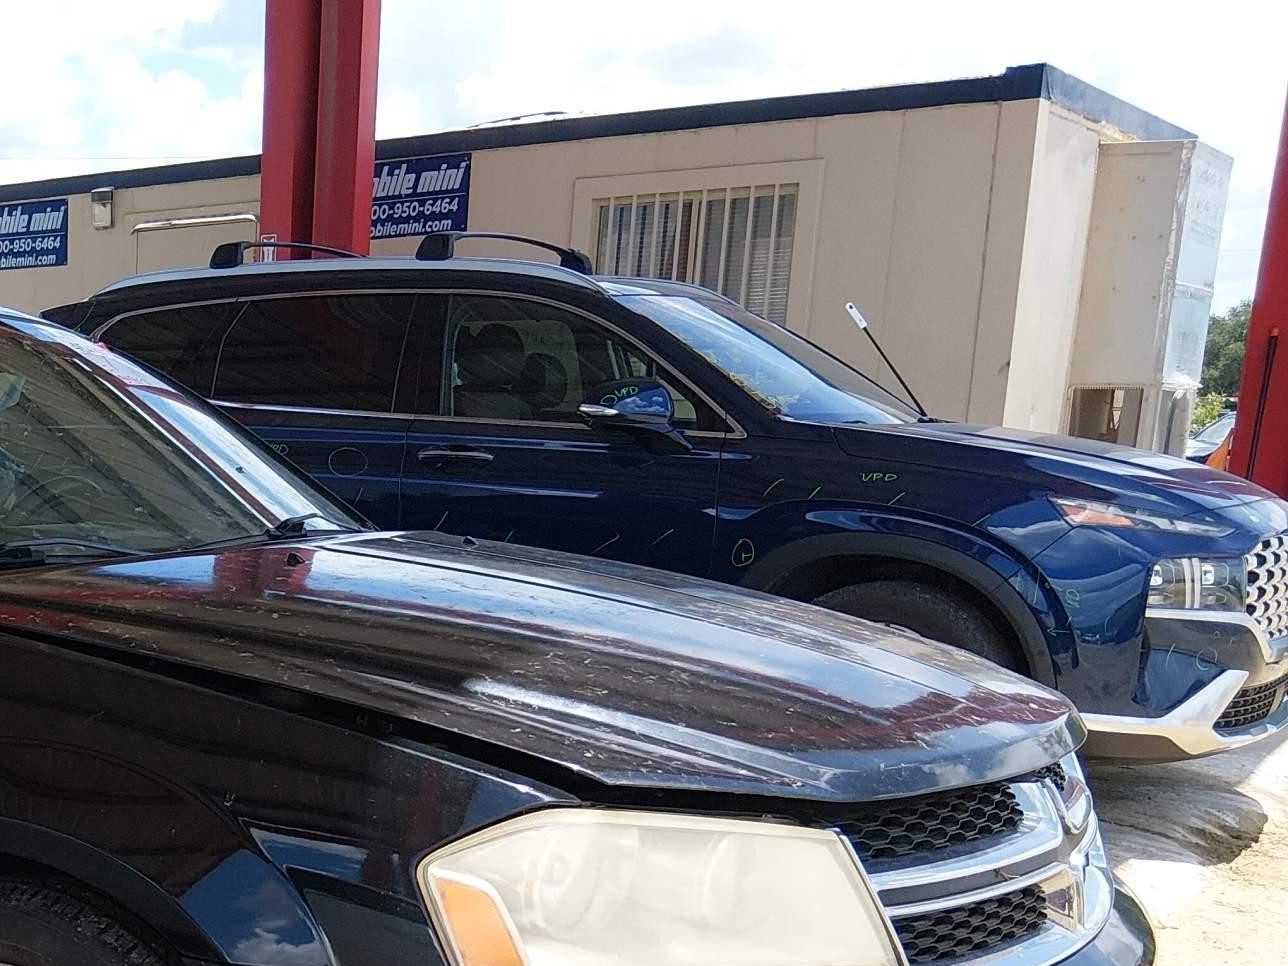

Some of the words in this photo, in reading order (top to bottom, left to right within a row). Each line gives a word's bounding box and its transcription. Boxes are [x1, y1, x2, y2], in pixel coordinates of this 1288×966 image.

[372, 163, 416, 198] obile
[416, 161, 467, 193] mini
[29, 206, 65, 232] mini
[370, 197, 459, 220] 00-950-6464
[370, 218, 452, 237] obilemini.com
[862, 472, 898, 482] VPD
